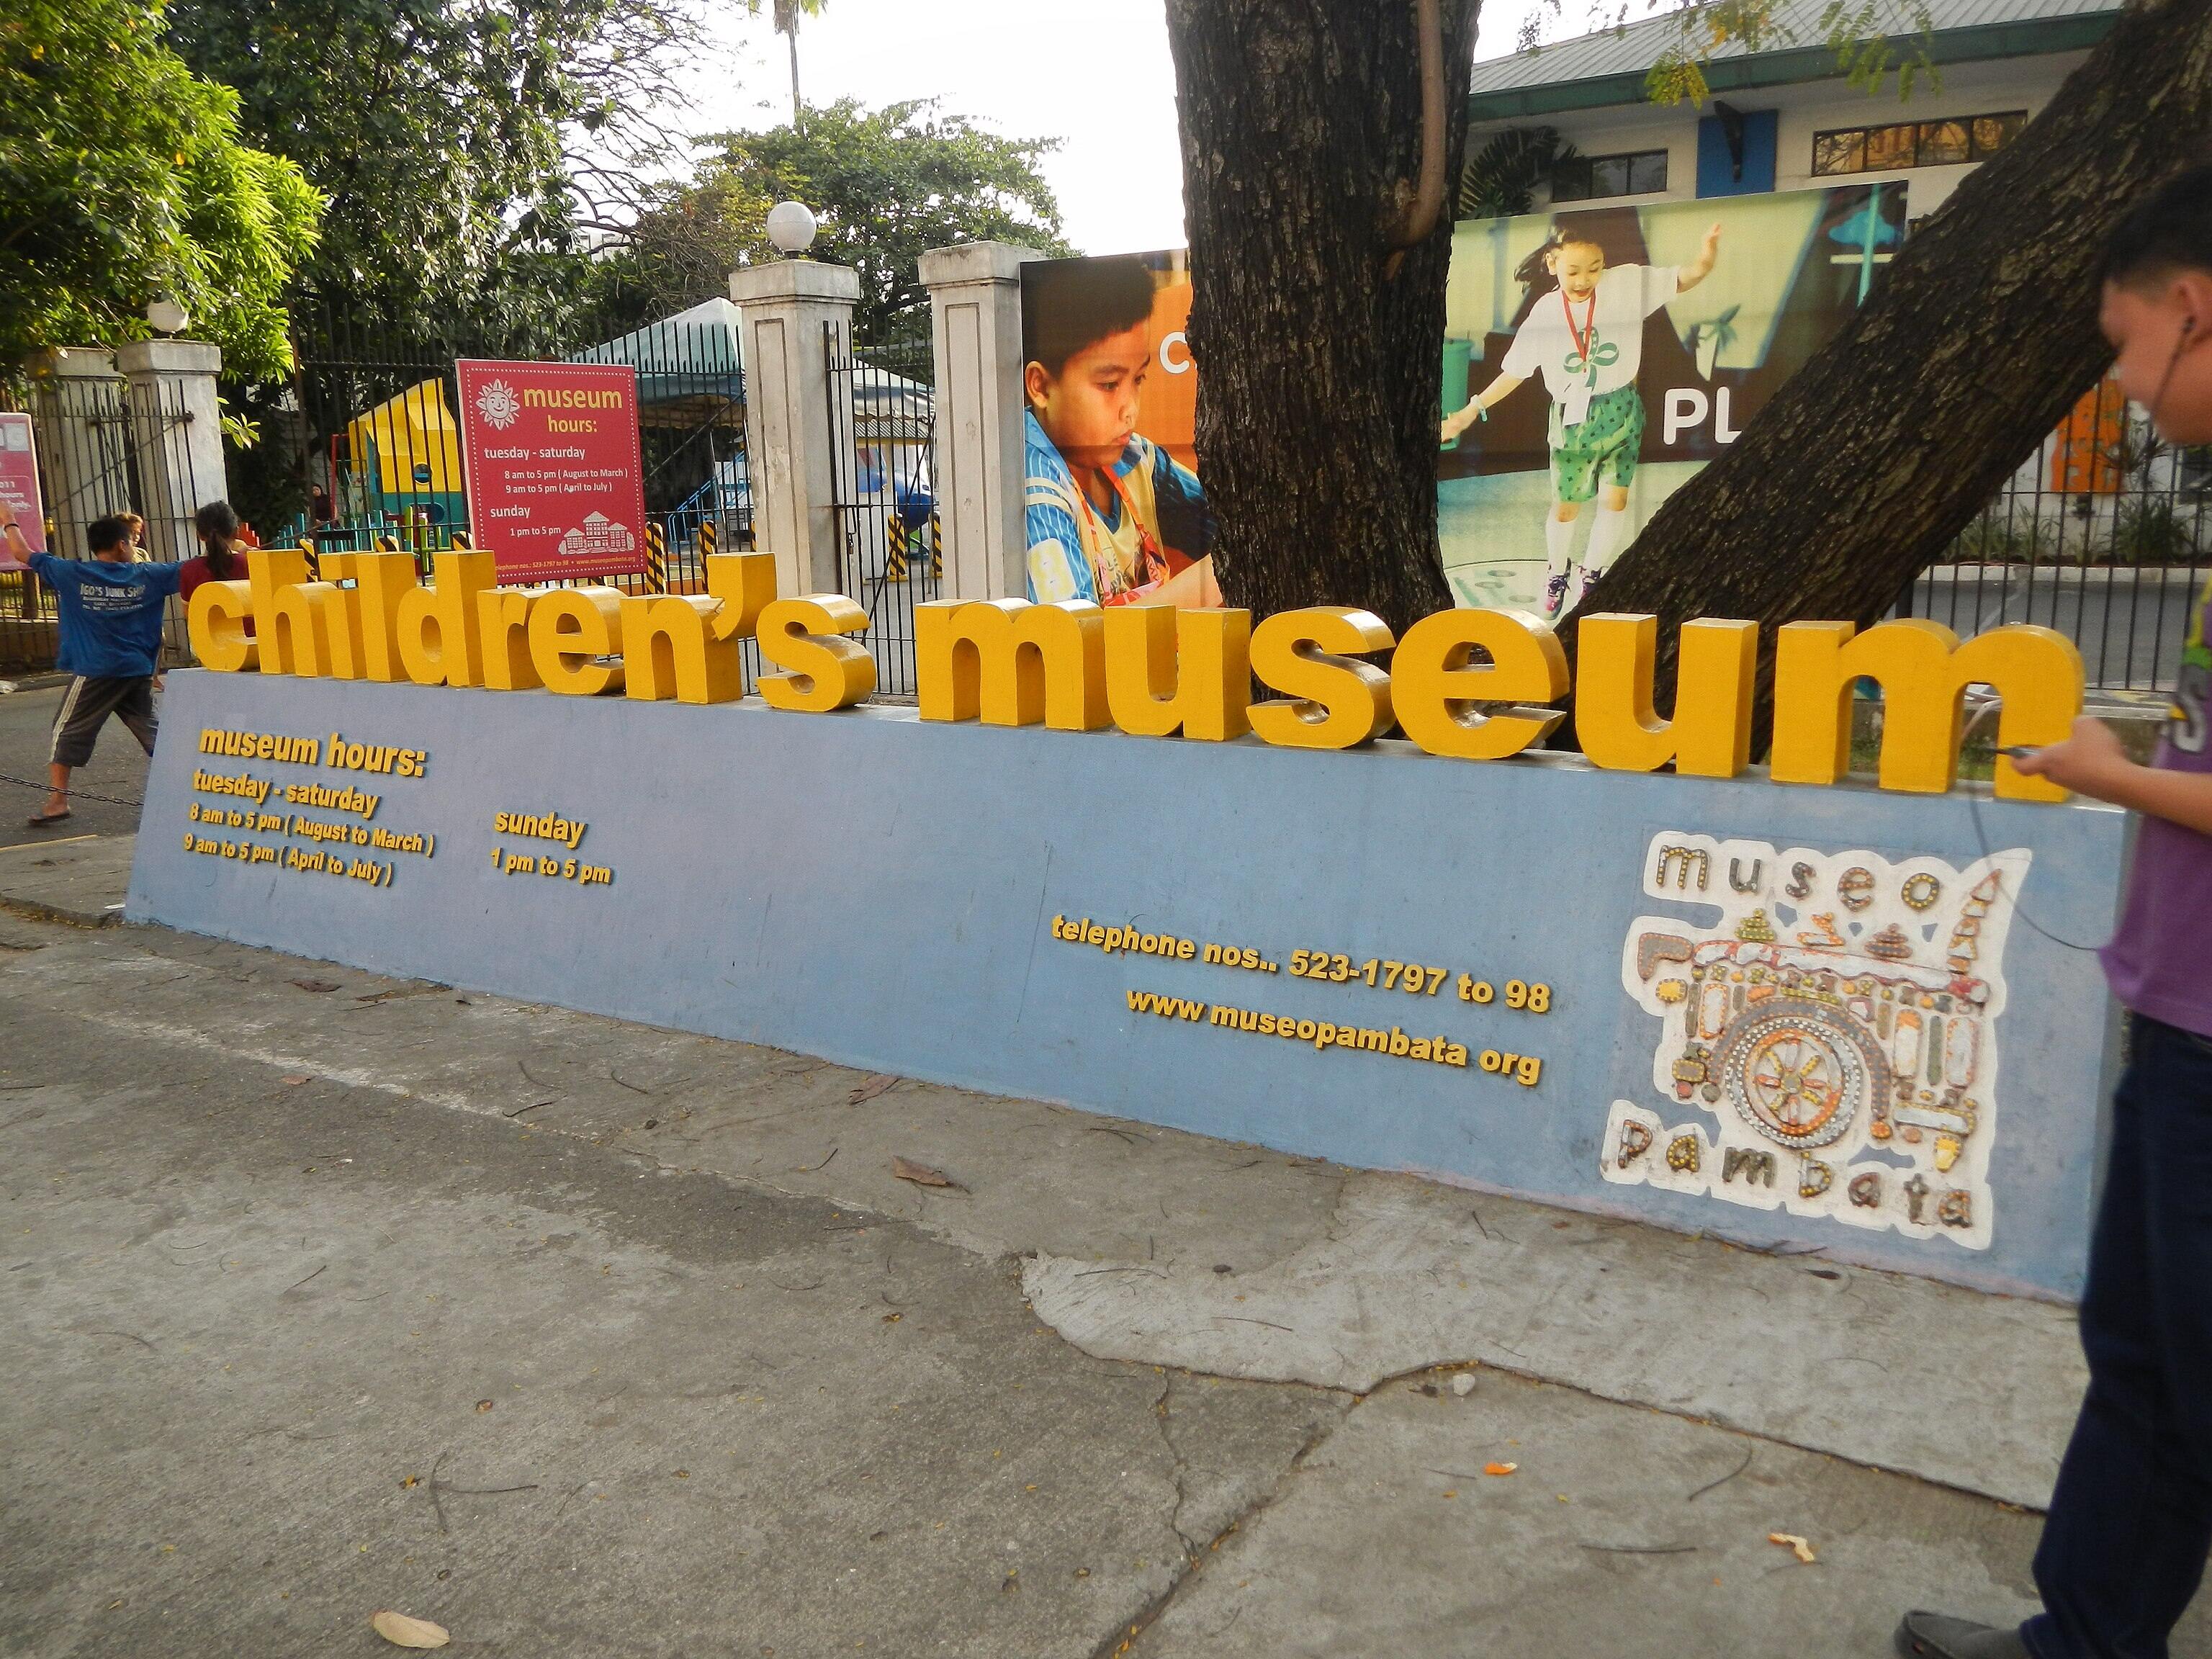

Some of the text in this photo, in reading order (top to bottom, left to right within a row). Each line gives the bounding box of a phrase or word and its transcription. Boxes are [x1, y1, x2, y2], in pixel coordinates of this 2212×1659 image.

[523, 388, 623, 409] museum
[547, 414, 598, 432] hours:
[484, 446, 529, 460] tuesday
[539, 446, 585, 460] saturday
[504, 470, 510, 480] 8
[526, 470, 534, 479] to
[537, 470, 541, 479] 5
[544, 471, 556, 480] pm
[562, 469, 589, 480] August
[590, 469, 598, 477] to
[600, 468, 624, 477] March
[505, 485, 511, 493] 9
[527, 485, 536, 493] to
[593, 482, 608, 492] July
[490, 504, 531, 519] sunday
[510, 527, 514, 536] 1
[531, 527, 539, 536] to
[549, 527, 561, 536] pm
[187, 548, 877, 713] children's
[914, 596, 2085, 804] museum
[198, 728, 427, 778] museum hours:
[192, 768, 381, 820] tuesday - saturday
[189, 802, 199, 821] 8
[201, 807, 224, 824] am
[226, 808, 243, 827] to
[246, 811, 256, 829] 5
[258, 813, 282, 832] pm
[294, 816, 349, 843] August
[351, 825, 369, 845] to
[371, 827, 423, 853] March
[493, 811, 589, 850] sunday
[183, 832, 194, 851] 9
[195, 837, 217, 855] am
[220, 837, 237, 858] to
[238, 841, 250, 861] 5
[251, 843, 276, 863] pm
[287, 846, 326, 872] April
[328, 855, 345, 875] to
[348, 858, 382, 887] July
[490, 846, 614, 886] 1 pm to 5 pm
[1655, 843, 1942, 913] museo
[1051, 914, 1552, 1014] telephone nos.. 523-1797 to 98
[1126, 989, 1543, 1087] www museopambata org
